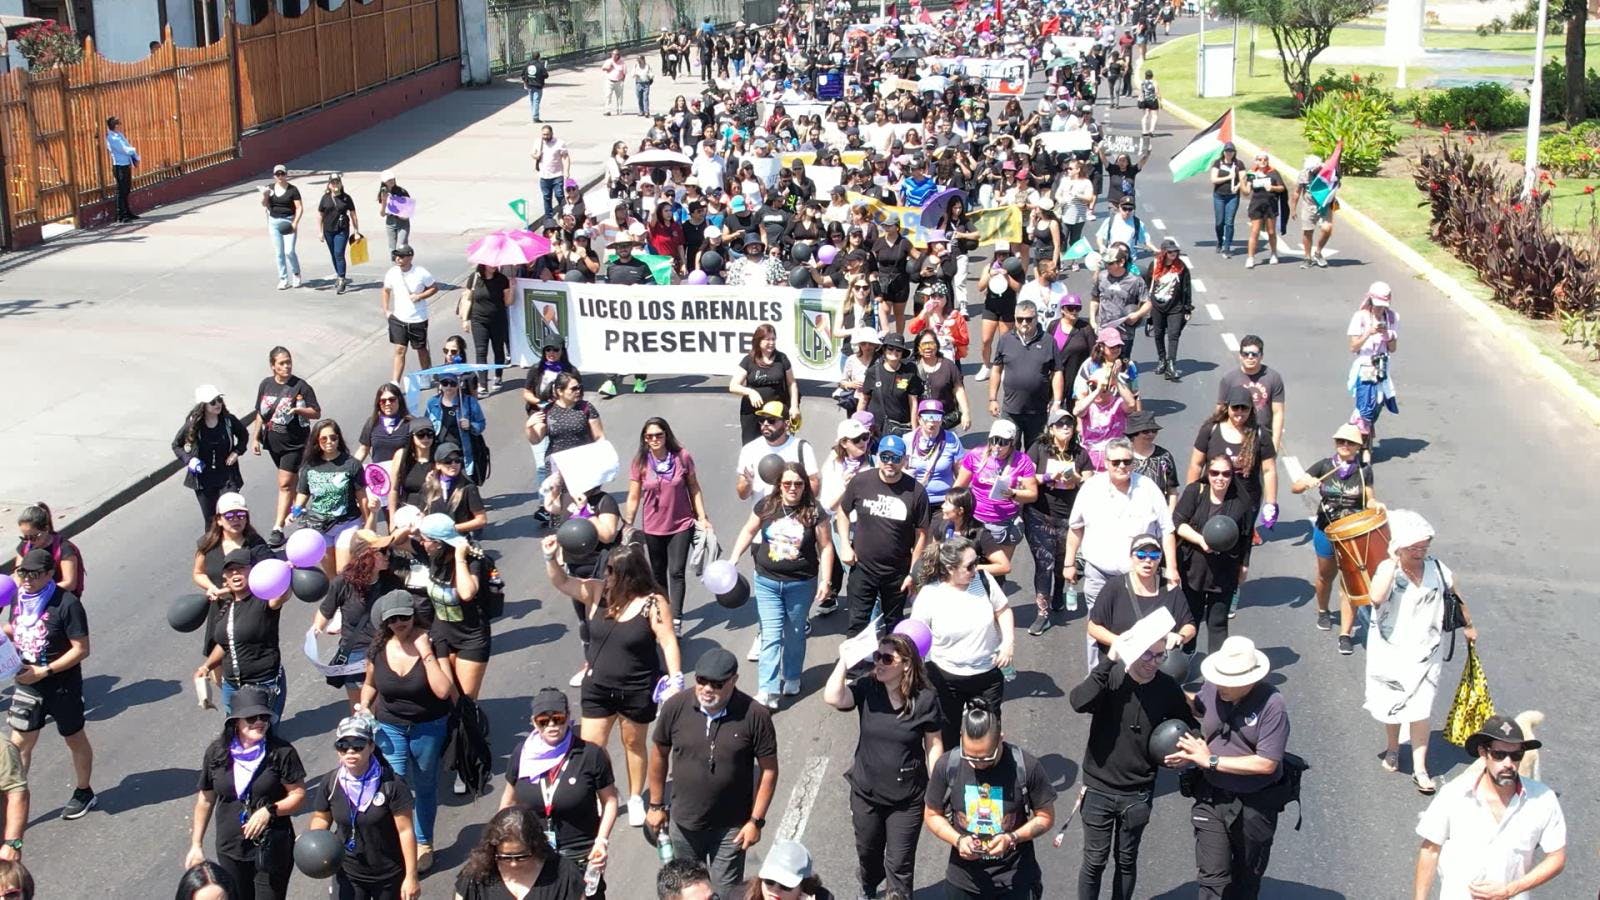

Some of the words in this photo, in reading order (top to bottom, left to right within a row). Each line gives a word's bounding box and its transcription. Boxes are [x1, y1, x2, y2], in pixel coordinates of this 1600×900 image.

[578, 297, 632, 320] LICEO
[638, 300, 676, 321] LOS
[681, 300, 783, 322] ARENALES
[604, 329, 754, 354] PRESENTE
[863, 498, 893, 511] NORTH
